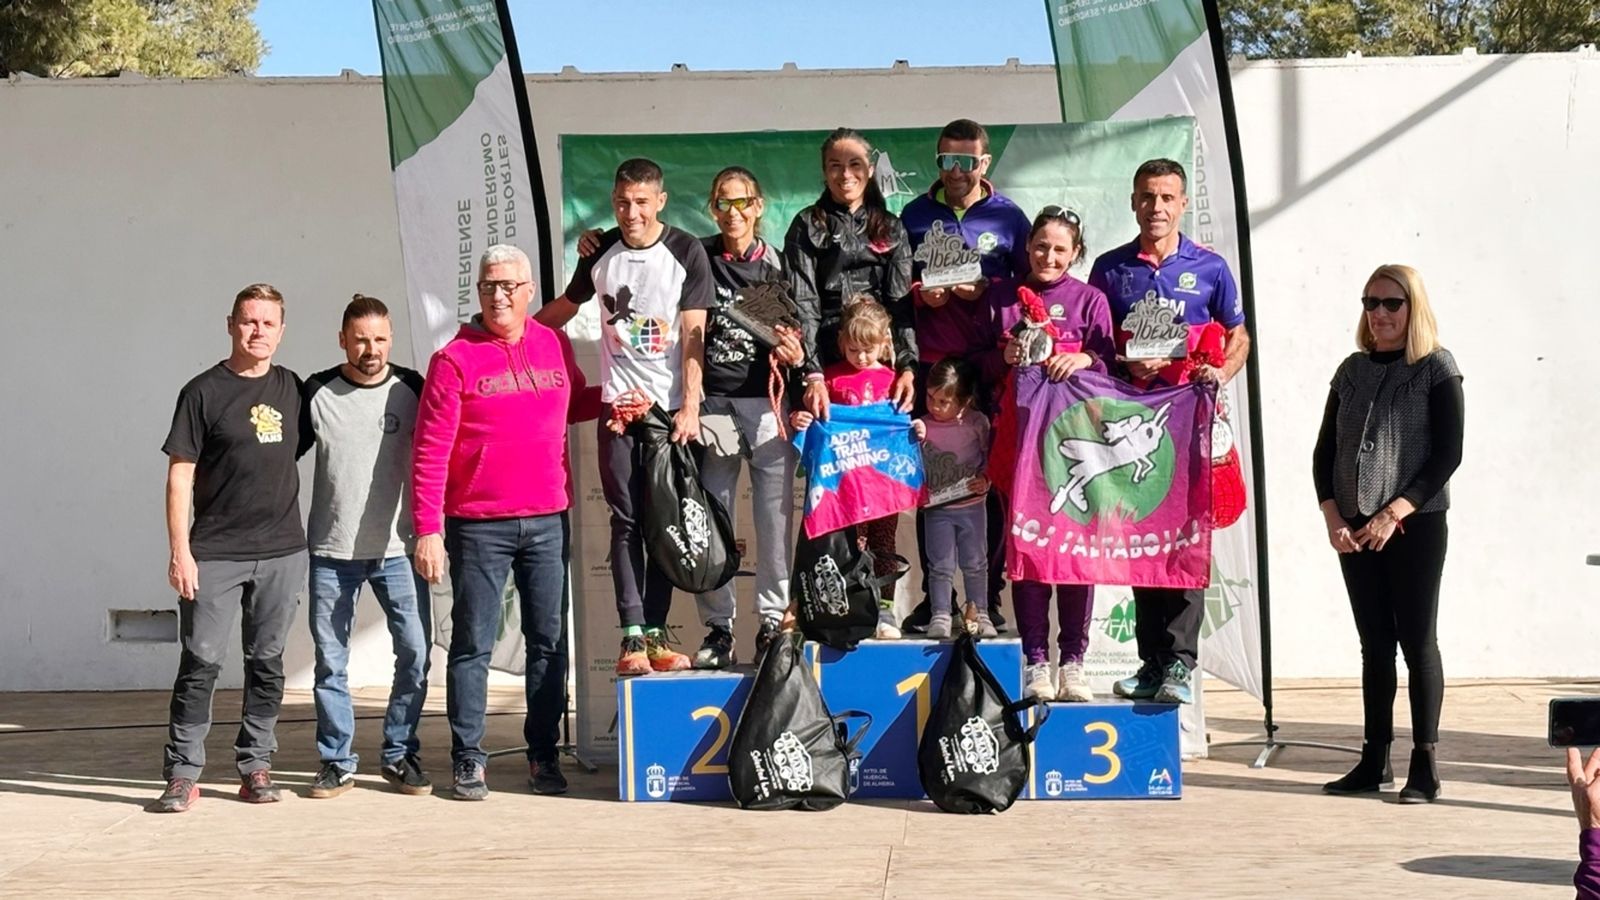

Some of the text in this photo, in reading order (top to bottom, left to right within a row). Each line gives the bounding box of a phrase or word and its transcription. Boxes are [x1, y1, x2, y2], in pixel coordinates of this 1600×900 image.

[256, 431, 283, 444] VANS
[829, 428, 871, 447] ADRA
[833, 440, 872, 459] TRAIL
[820, 449, 891, 478] RUNNING
[1011, 512, 1056, 547] LOS
[1059, 519, 1200, 560] SALTABOJAS
[691, 706, 731, 774] 2
[1083, 721, 1122, 784] 3
